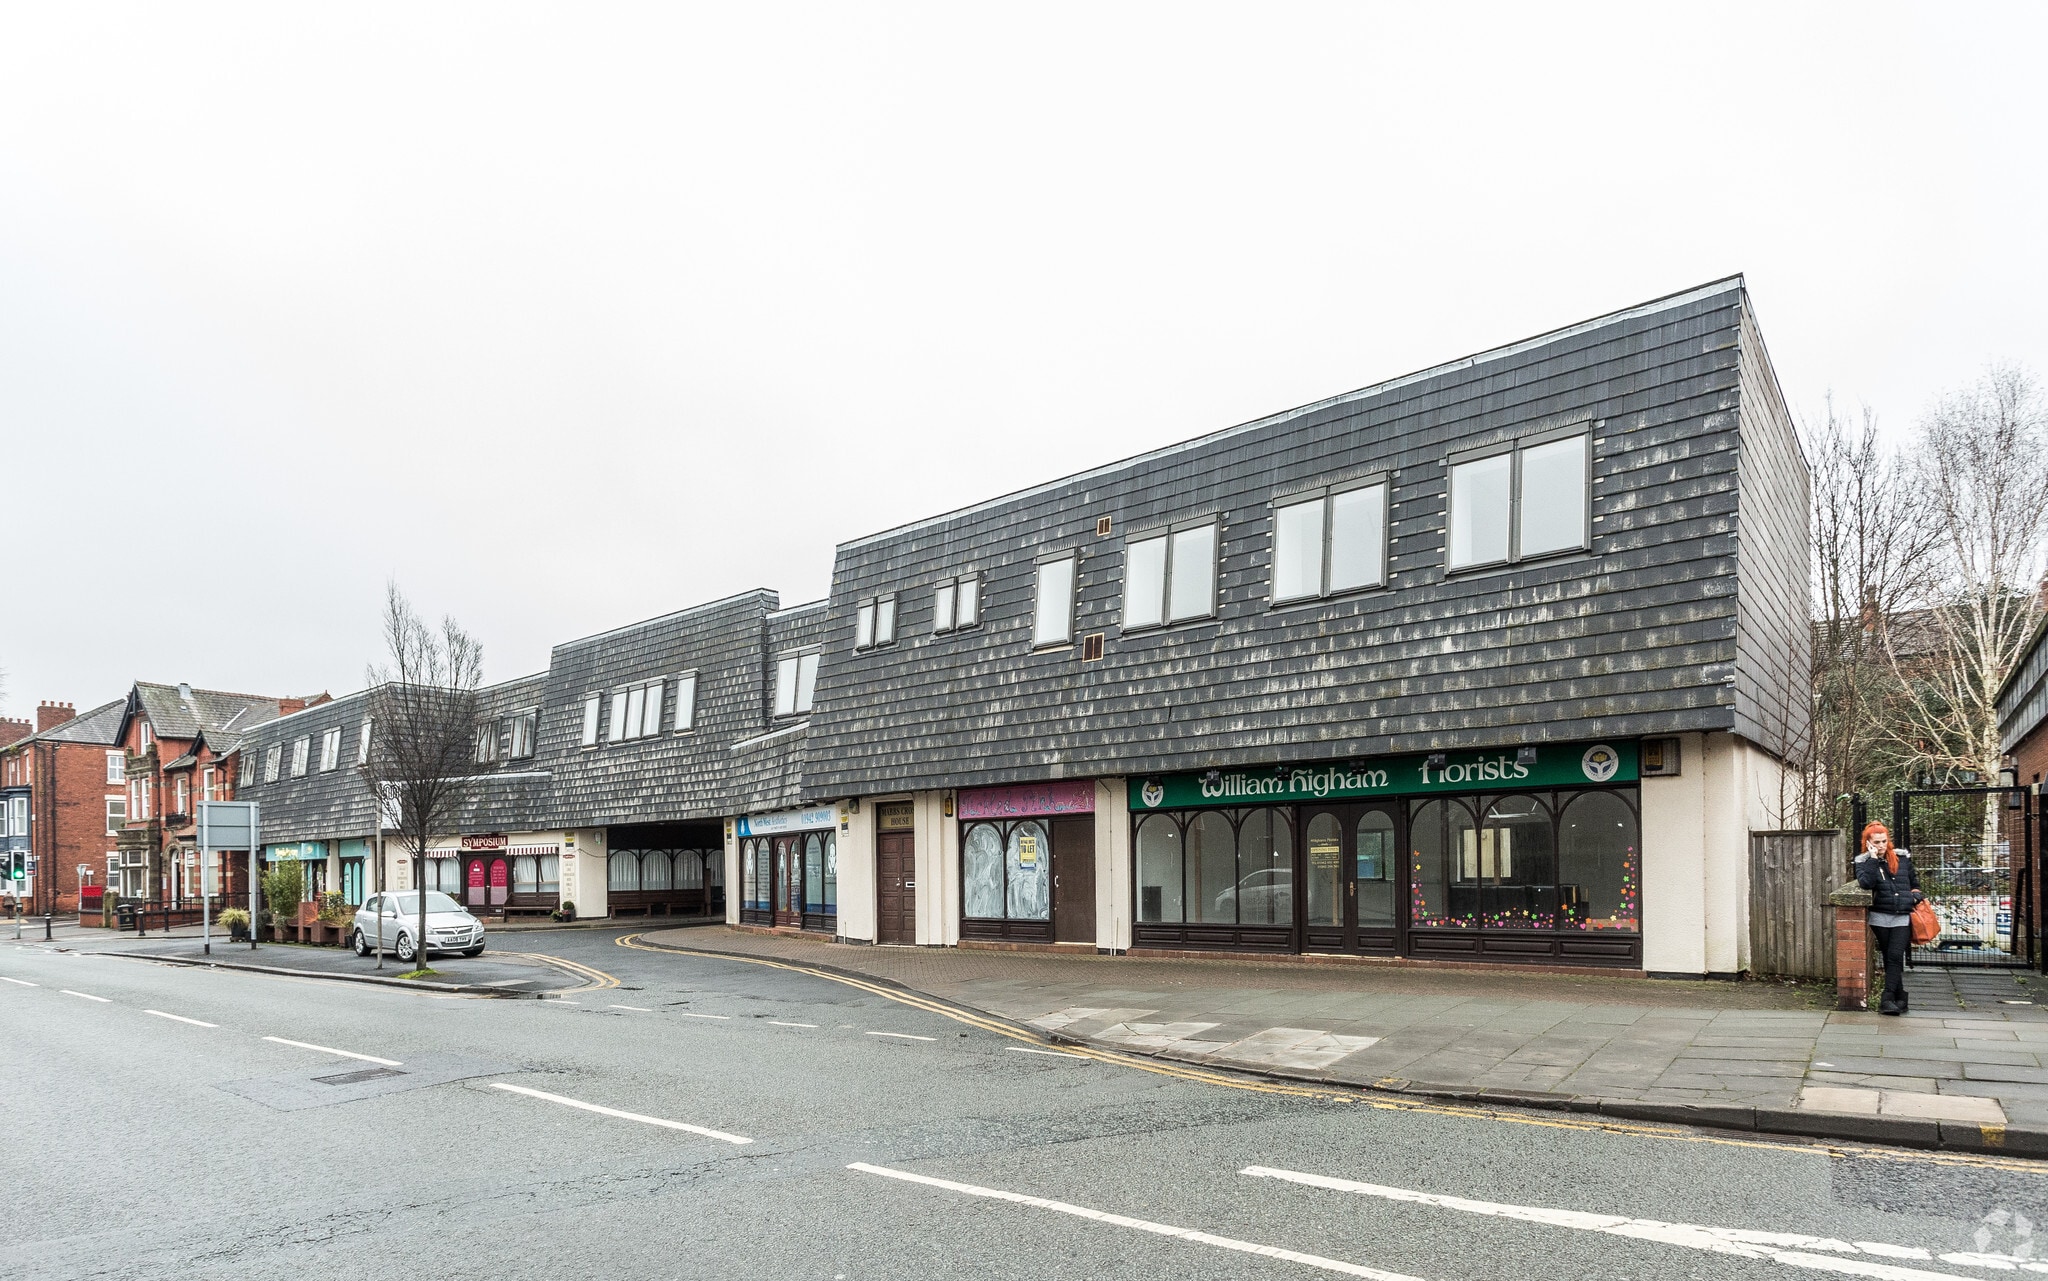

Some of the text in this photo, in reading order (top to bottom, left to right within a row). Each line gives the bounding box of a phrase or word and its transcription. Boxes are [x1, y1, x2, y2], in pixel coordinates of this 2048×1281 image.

[1198, 774, 1284, 798] William
[890, 817, 910, 826] HOUSE
[463, 837, 506, 847] SYMPOSIUM
[1020, 845, 1035, 853] TO LET
